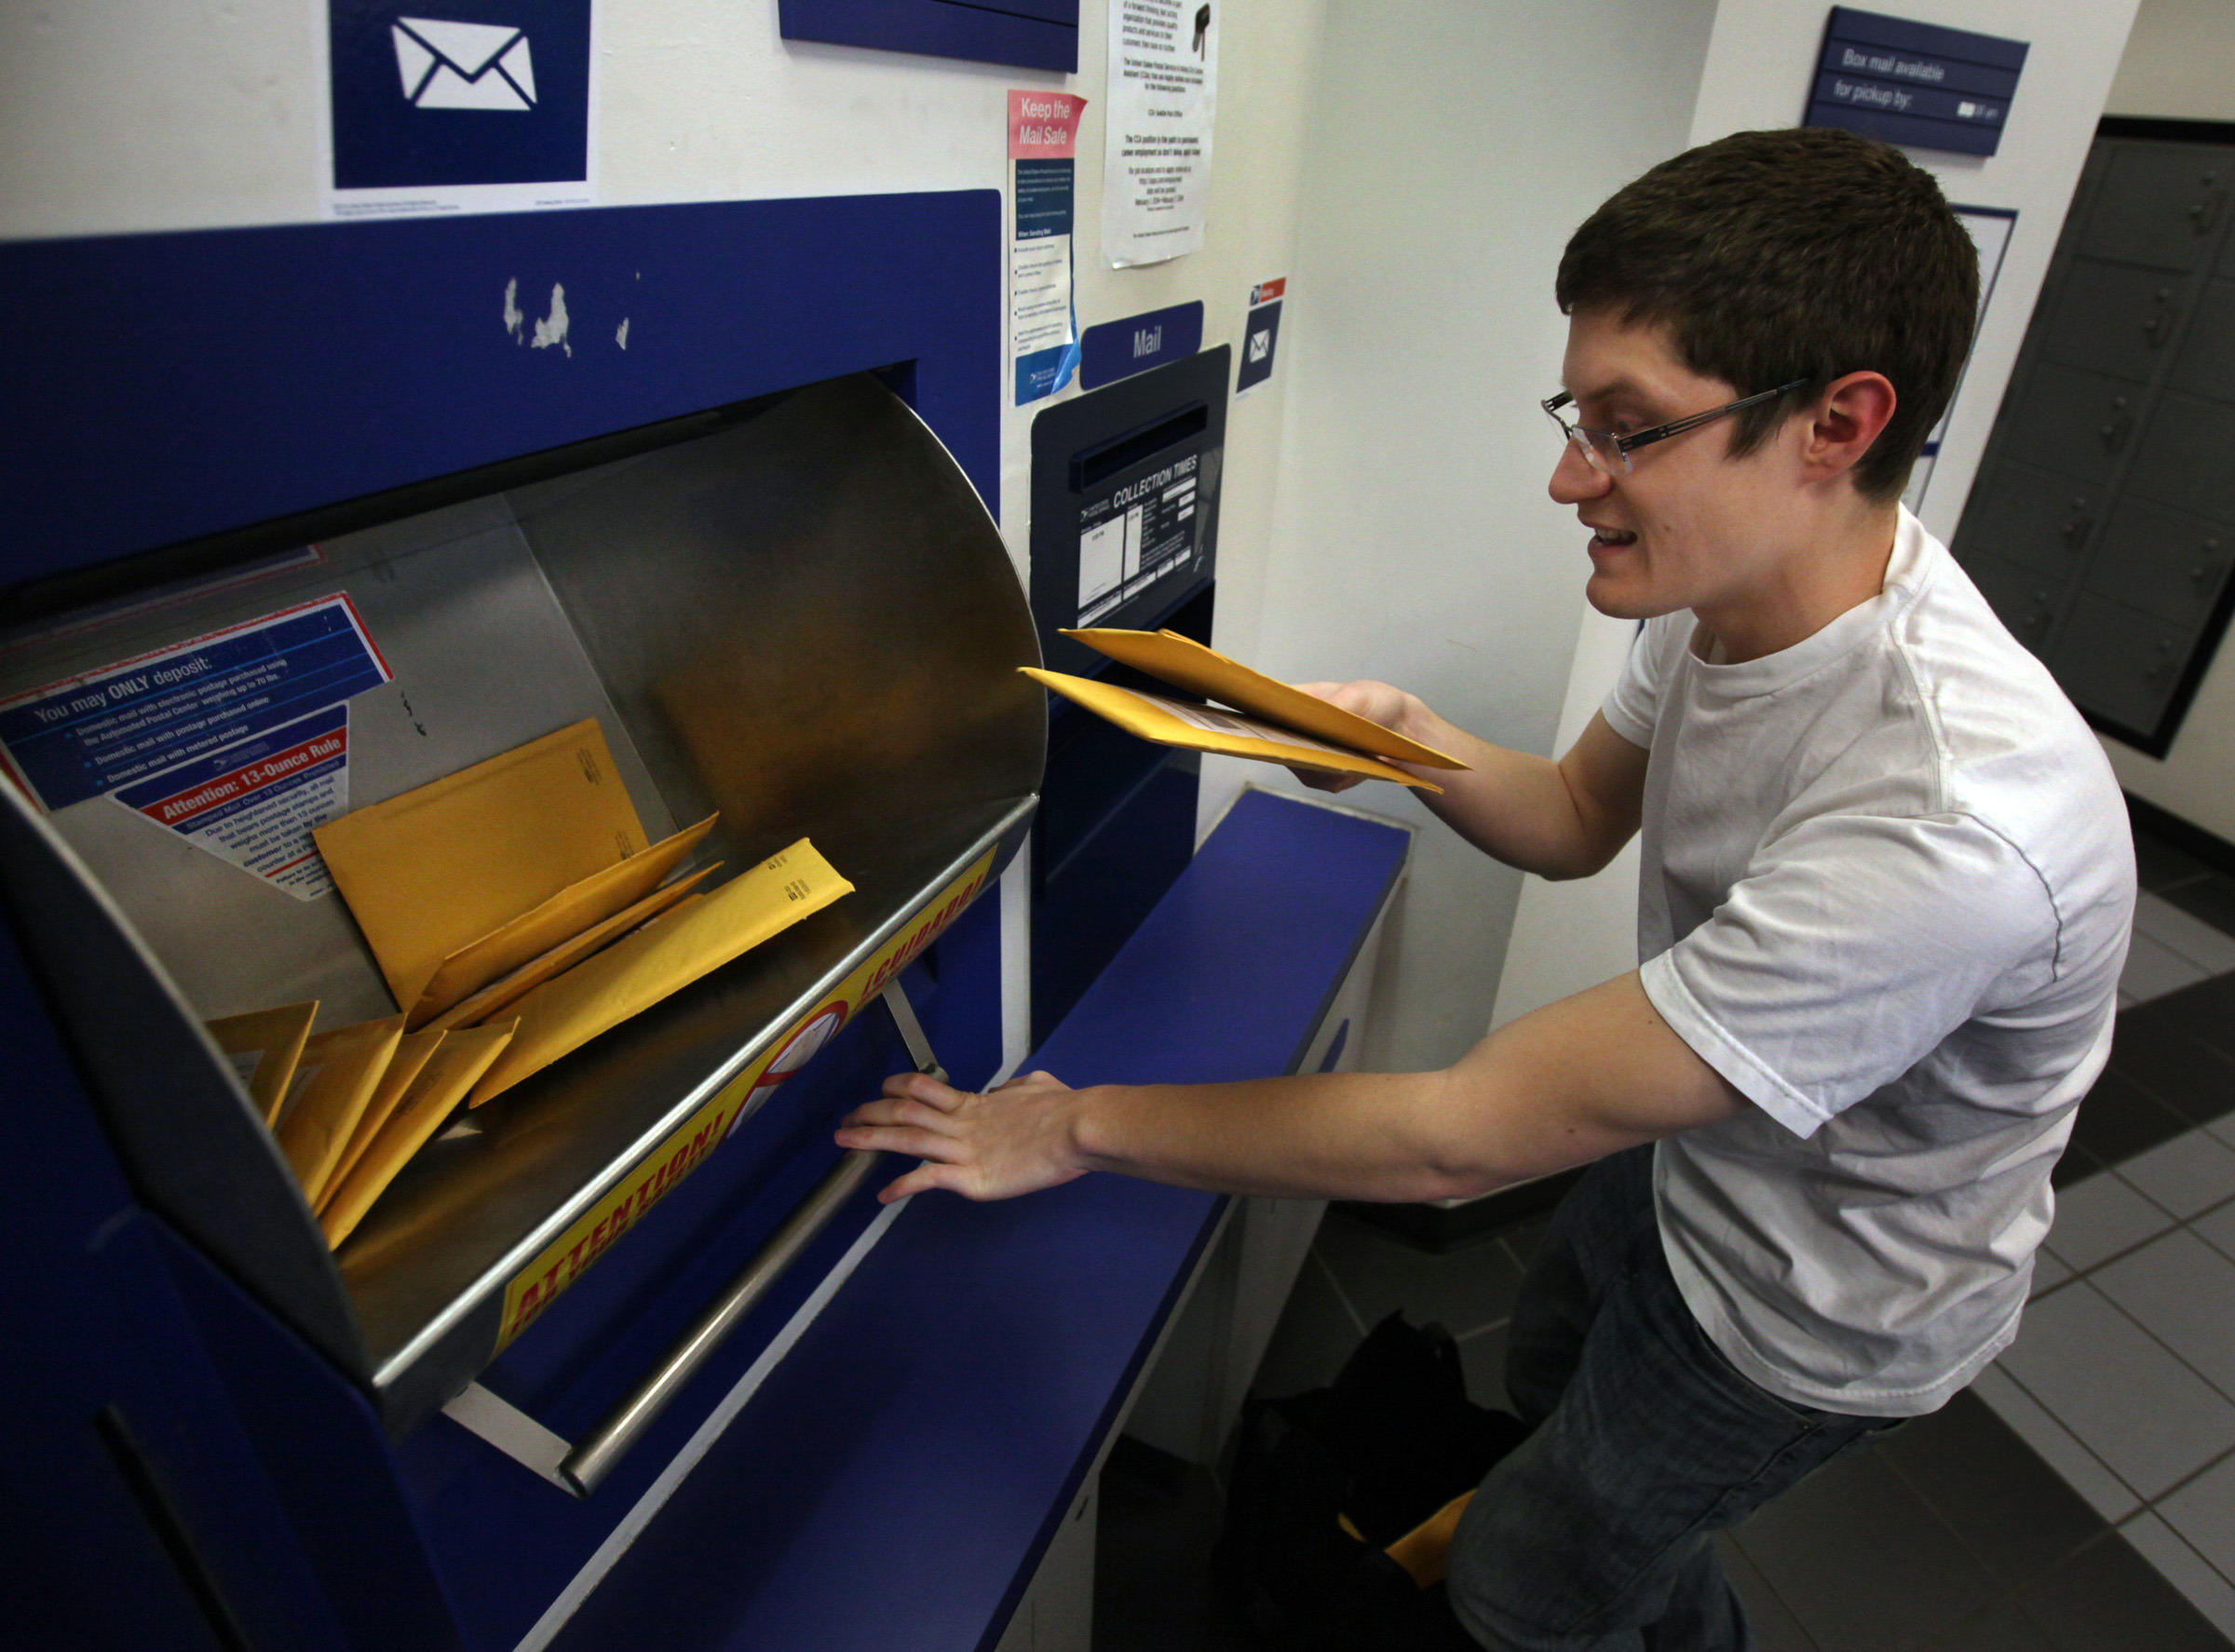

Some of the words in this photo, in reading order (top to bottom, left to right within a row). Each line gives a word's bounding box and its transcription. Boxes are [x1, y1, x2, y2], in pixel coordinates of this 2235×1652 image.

[1843, 48, 1867, 66] Box
[1868, 56, 1895, 74] mail
[1894, 61, 1944, 82] available
[1022, 97, 1052, 121] Keep
[1054, 101, 1069, 119] the
[1834, 80, 1851, 97] for
[1853, 84, 1892, 106] pickup
[1892, 89, 1913, 110] by:
[1020, 125, 1041, 144] Mail
[1043, 126, 1067, 145] Safe
[1133, 325, 1162, 358] Mail
[1114, 466, 1172, 508] COLLECTION
[1173, 454, 1198, 479] TIMES
[34, 704, 69, 723] You
[71, 693, 107, 712] may
[108, 675, 149, 698] ONLY
[153, 657, 212, 685] deposit:
[76, 717, 117, 736] Domestic
[119, 710, 138, 721] mail
[139, 703, 157, 715] with
[158, 689, 197, 708] electronic
[197, 678, 227, 697] postage
[229, 664, 266, 685] purchased
[266, 657, 288, 670] using
[84, 736, 101, 747] the
[101, 719, 146, 741] Automated
[147, 711, 172, 724] Postal
[173, 702, 198, 715] Center
[201, 688, 237, 705] weighing
[237, 684, 248, 695] up
[95, 747, 136, 765] Domestic
[137, 738, 156, 750] mail
[156, 732, 175, 743] with
[175, 719, 207, 736] postage
[208, 704, 247, 724] purchased
[248, 697, 270, 710] online
[106, 763, 147, 782] Domestic
[148, 755, 168, 767] mail
[168, 748, 186, 760] with
[186, 736, 218, 752] metered
[219, 724, 249, 741] postage
[163, 780, 240, 819] Attention:
[240, 752, 309, 790] 13-Ounce
[309, 738, 342, 759] Rule
[186, 810, 224, 831] Stamped
[224, 801, 241, 819] Mail
[242, 793, 261, 806] Over
[263, 789, 273, 798] 13
[274, 779, 302, 793] Ounces
[304, 761, 339, 779] Prohibited
[205, 825, 224, 836] Due
[234, 802, 277, 825] heightened
[278, 789, 311, 805] security,
[310, 783, 318, 792] all
[319, 777, 335, 788] mail
[219, 833, 236, 842] that
[237, 821, 260, 835] bears
[260, 808, 291, 827] postage
[292, 795, 318, 812] stamps
[319, 788, 333, 799] and
[230, 834, 259, 849] weighs
[259, 823, 279, 836] more
[279, 816, 298, 827] than
[298, 810, 308, 819] 13
[308, 799, 335, 815] ounces
[250, 840, 270, 853] must
[270, 834, 281, 844] be
[281, 825, 304, 838] taken
[303, 820, 313, 831] by
[313, 814, 328, 825] the
[243, 846, 283, 868] customer
[282, 841, 292, 849] to
[257, 855, 287, 873] counter
[287, 849, 296, 859] at
[513, 1109, 725, 1321] ATTENTION!
